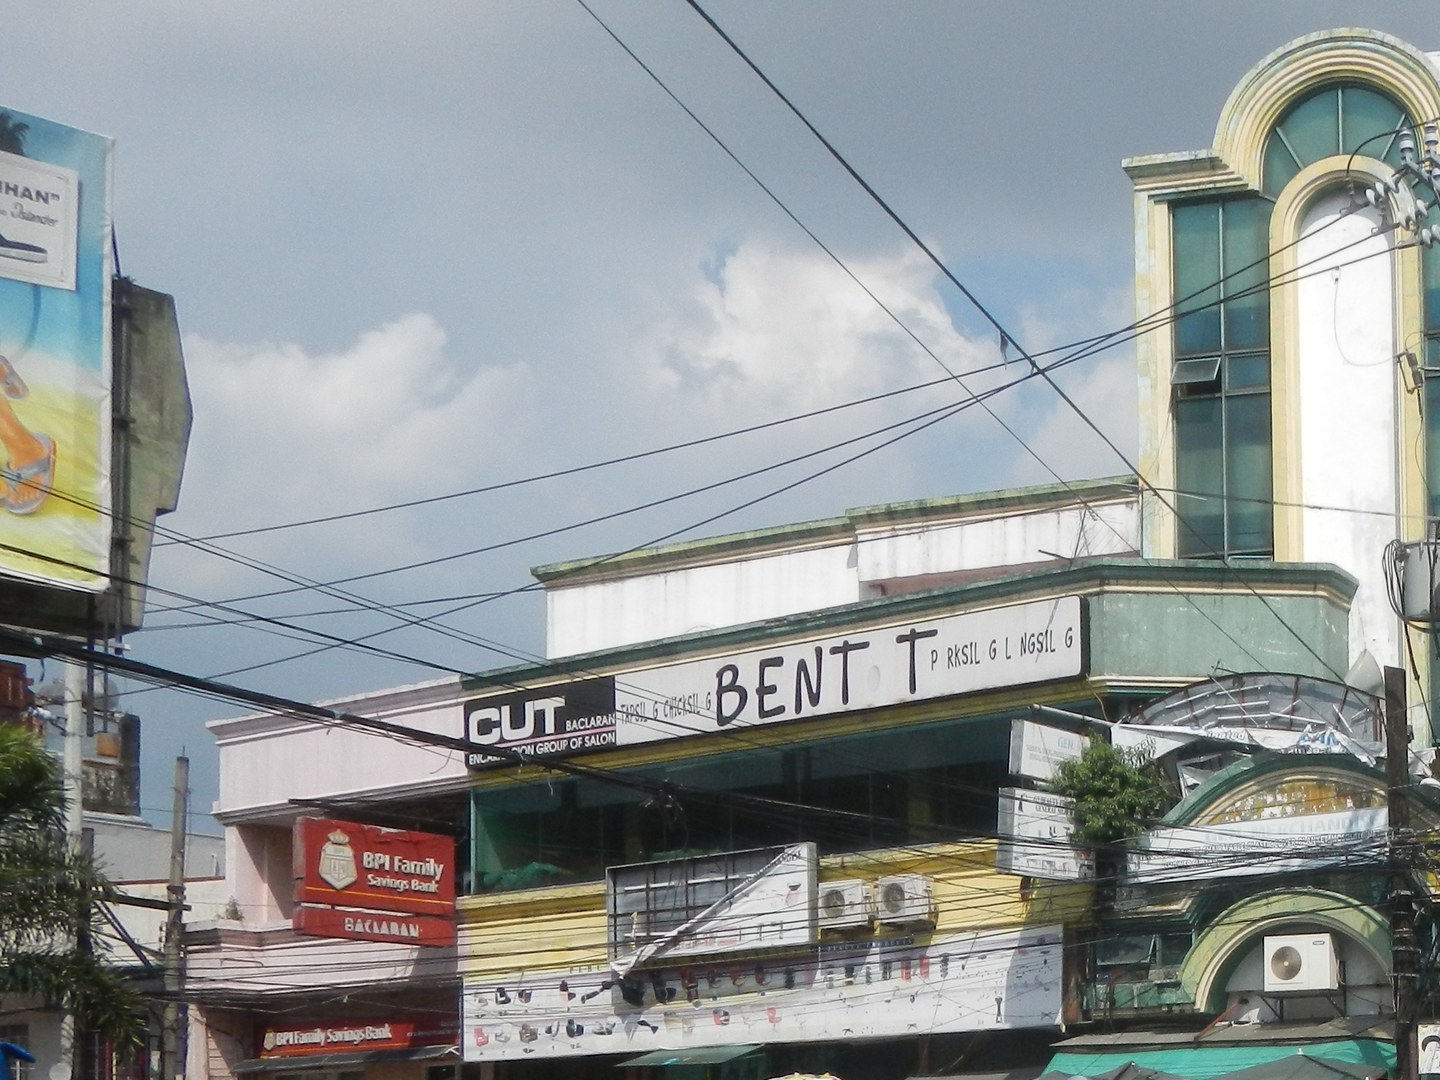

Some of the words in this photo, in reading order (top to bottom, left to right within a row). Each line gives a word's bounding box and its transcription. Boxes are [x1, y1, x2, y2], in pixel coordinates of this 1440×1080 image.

[468, 695, 566, 746] CUT
[565, 713, 616, 732] BACLARAN
[535, 740, 569, 754] GROUP
[571, 738, 583, 750] OF
[584, 732, 616, 748] SALON
[363, 851, 390, 871] BPI
[394, 855, 444, 882] Family
[367, 873, 410, 892] Savings
[411, 879, 440, 893] Bank
[344, 916, 419, 938] BACLARAN
[276, 1031, 295, 1046] BPI
[295, 1027, 326, 1046] Family
[327, 1026, 365, 1045] Savings
[365, 1023, 392, 1041] Bank
